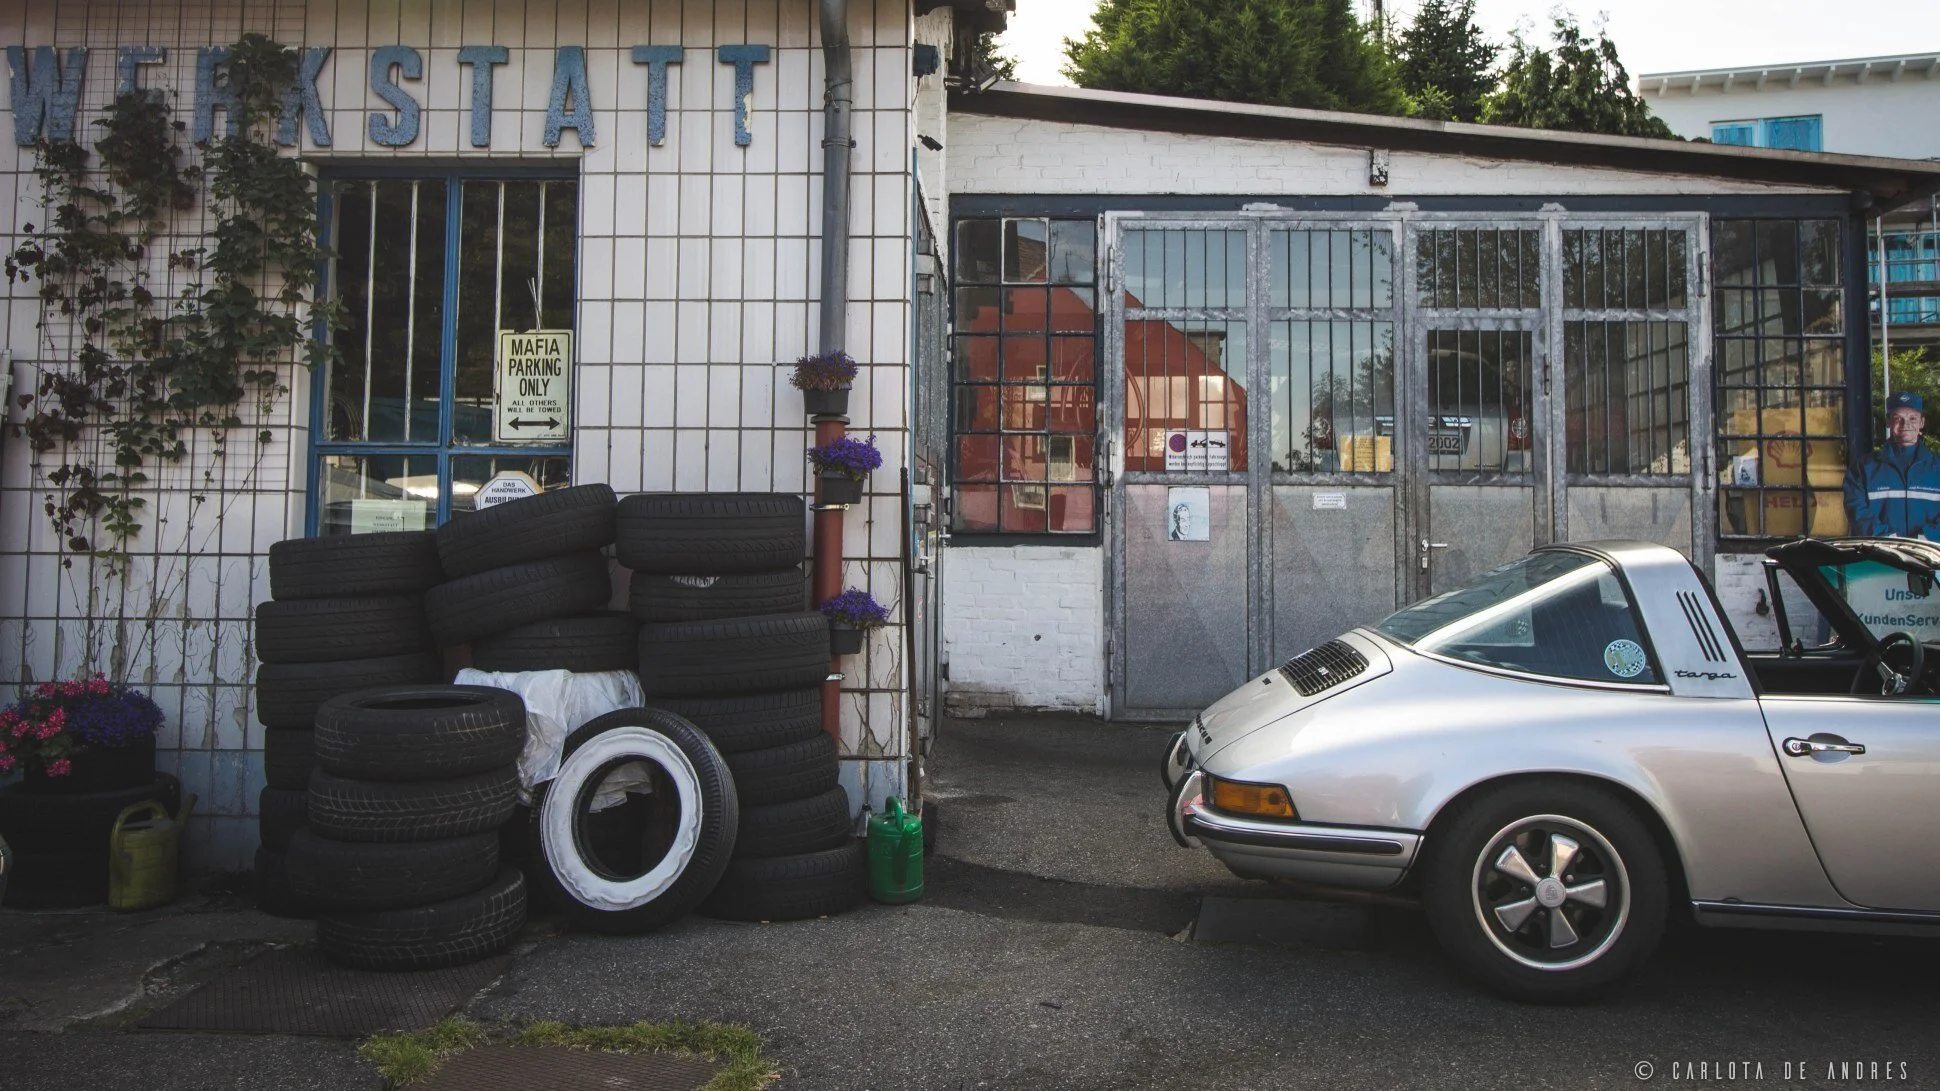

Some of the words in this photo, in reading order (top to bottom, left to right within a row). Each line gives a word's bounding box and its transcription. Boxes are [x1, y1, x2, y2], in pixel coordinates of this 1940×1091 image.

[511, 338, 560, 356] MAFIA
[508, 358, 562, 377] PARKING
[519, 377, 550, 397] ONLY
[1428, 437, 1460, 449] 2002
[1859, 613, 1940, 627] undenServ
[1674, 669, 1738, 681] targa
